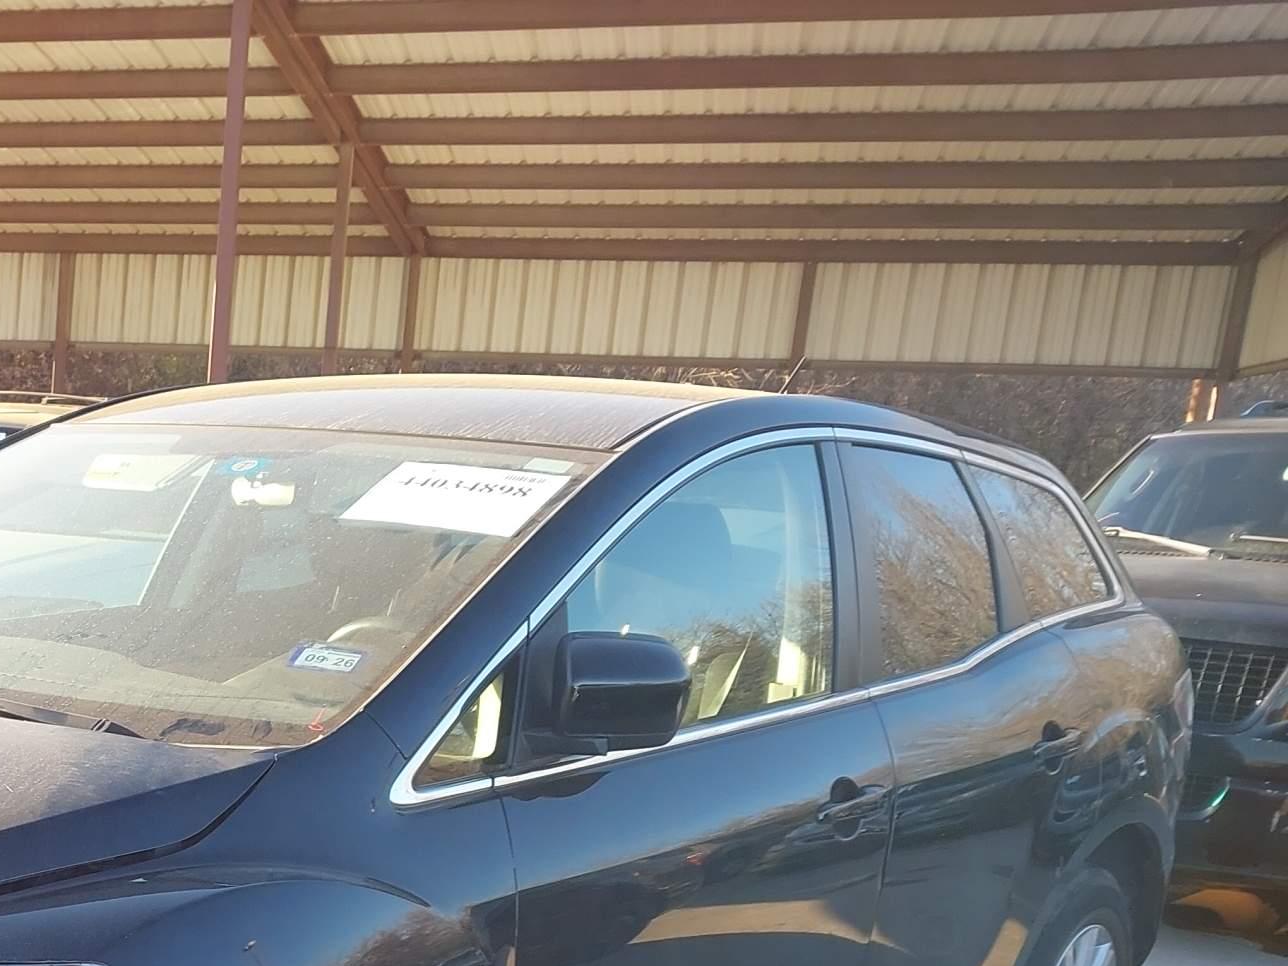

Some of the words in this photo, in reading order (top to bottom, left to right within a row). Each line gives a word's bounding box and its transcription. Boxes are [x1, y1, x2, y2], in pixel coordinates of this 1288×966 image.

[399, 476, 533, 497] 44034898
[304, 653, 327, 664] 09
[332, 657, 355, 668] 26
